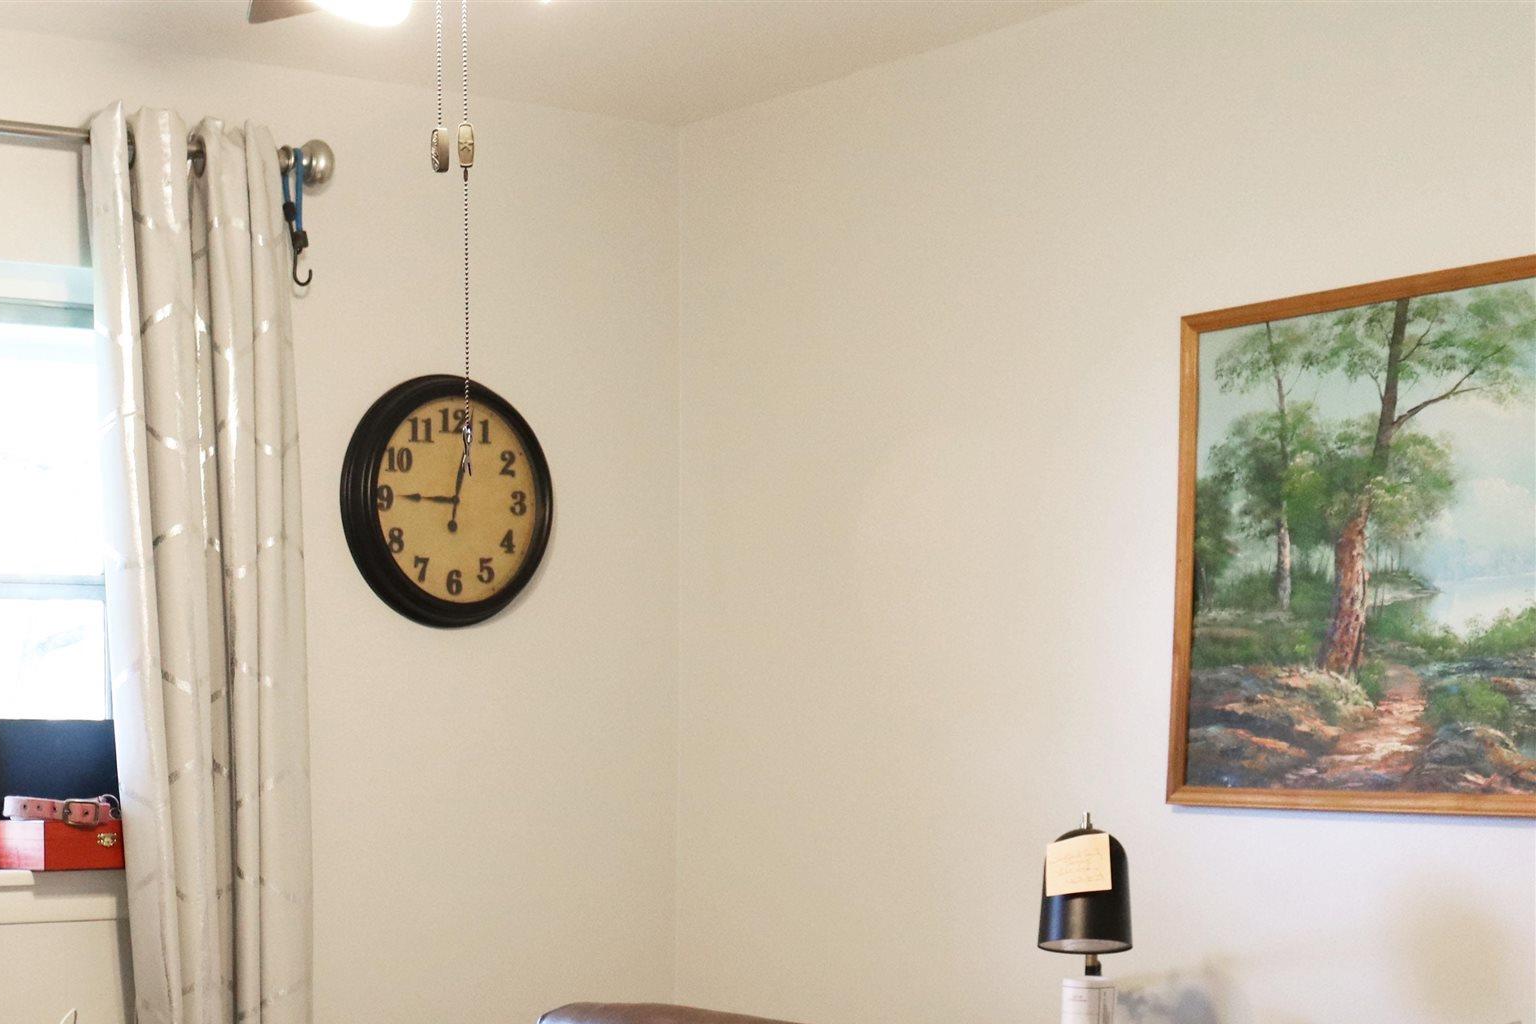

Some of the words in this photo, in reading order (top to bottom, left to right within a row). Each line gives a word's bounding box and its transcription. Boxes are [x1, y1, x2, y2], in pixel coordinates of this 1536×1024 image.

[408, 417, 434, 443] 11
[439, 408, 467, 434] 12
[478, 419, 492, 444] 1
[385, 447, 413, 473] 10
[499, 451, 515, 478] 2
[377, 484, 394, 511] 9
[510, 491, 527, 516] 3
[388, 527, 404, 553] 8
[500, 529, 515, 554] 4
[414, 556, 430, 582] 7
[446, 569, 462, 595] 6
[477, 557, 495, 584] 5
